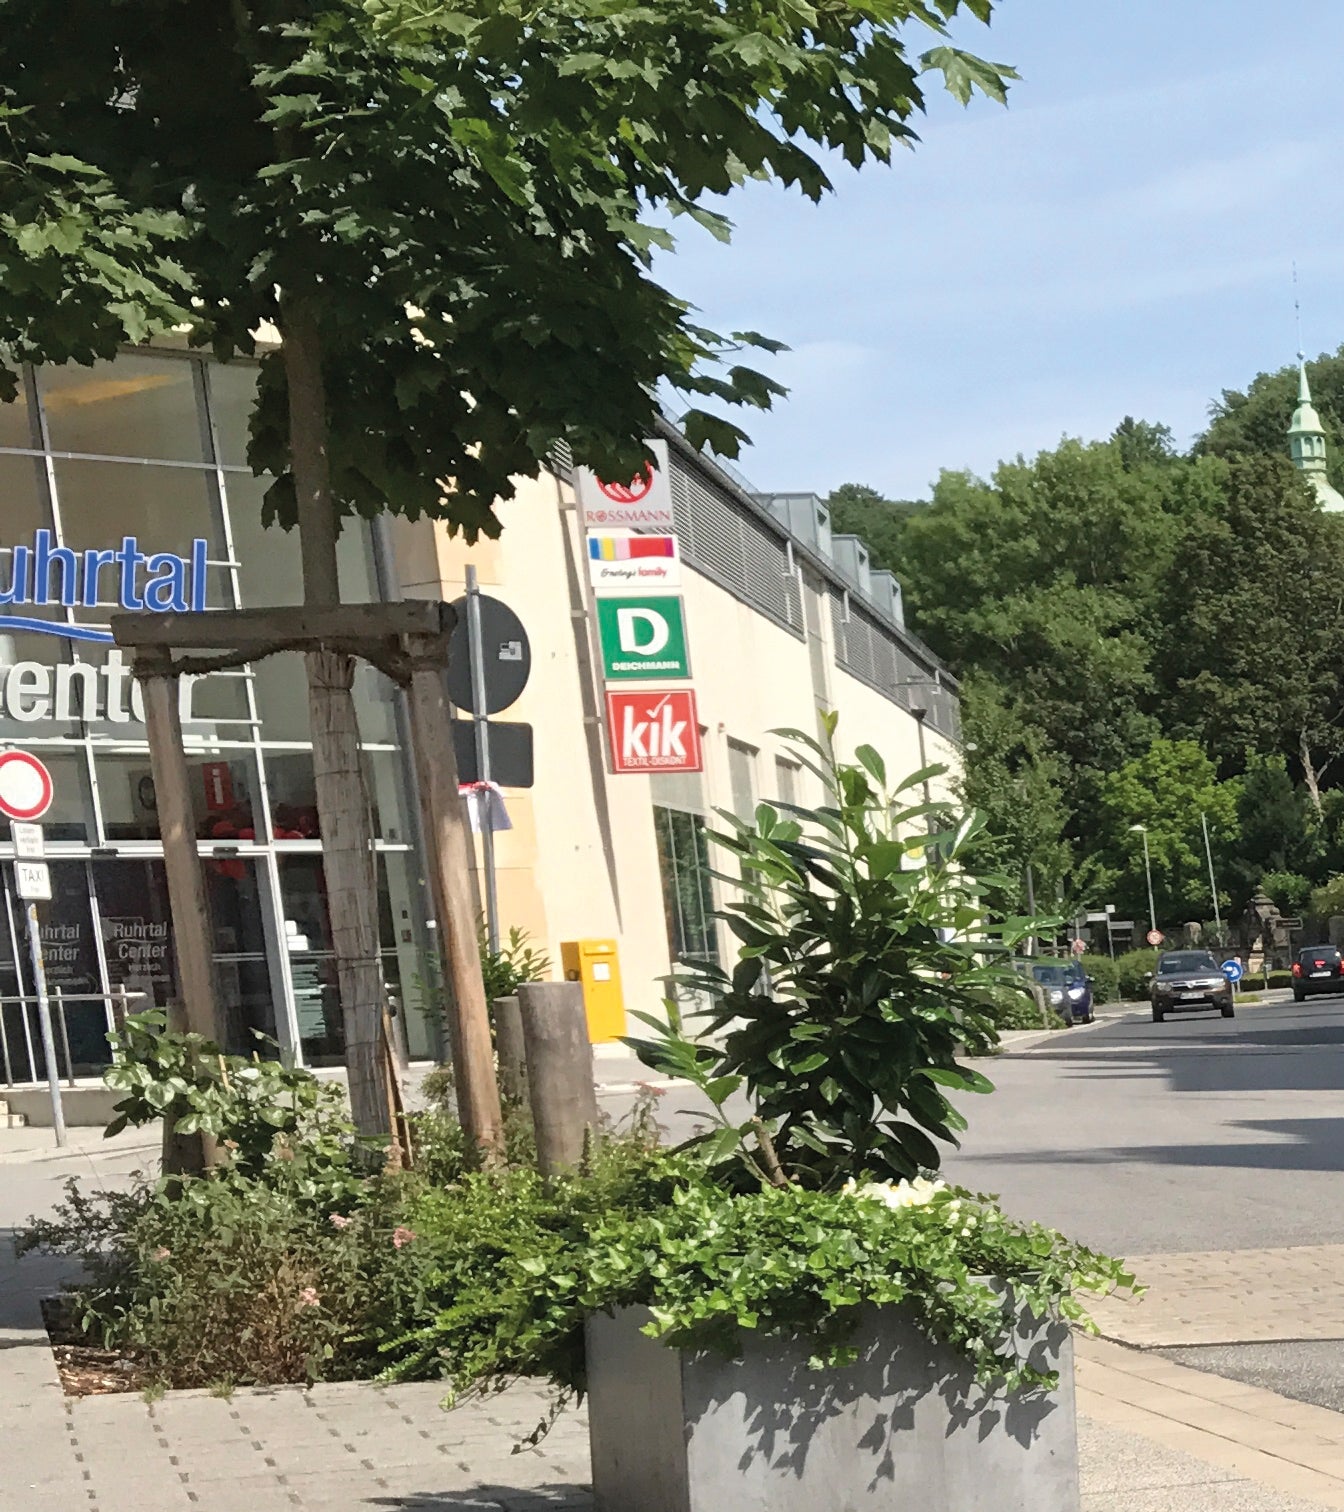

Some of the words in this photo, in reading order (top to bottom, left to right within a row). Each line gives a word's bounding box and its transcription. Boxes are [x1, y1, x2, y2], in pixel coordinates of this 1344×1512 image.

[586, 510, 670, 522] ROSSMANN
[617, 608, 669, 655] D
[612, 661, 680, 671] DEICHMANN
[0, 634, 207, 723] entr
[623, 694, 687, 757] kik
[22, 868, 44, 882] TAXI
[114, 921, 167, 939] Ruhrtal
[119, 943, 167, 960] Center
